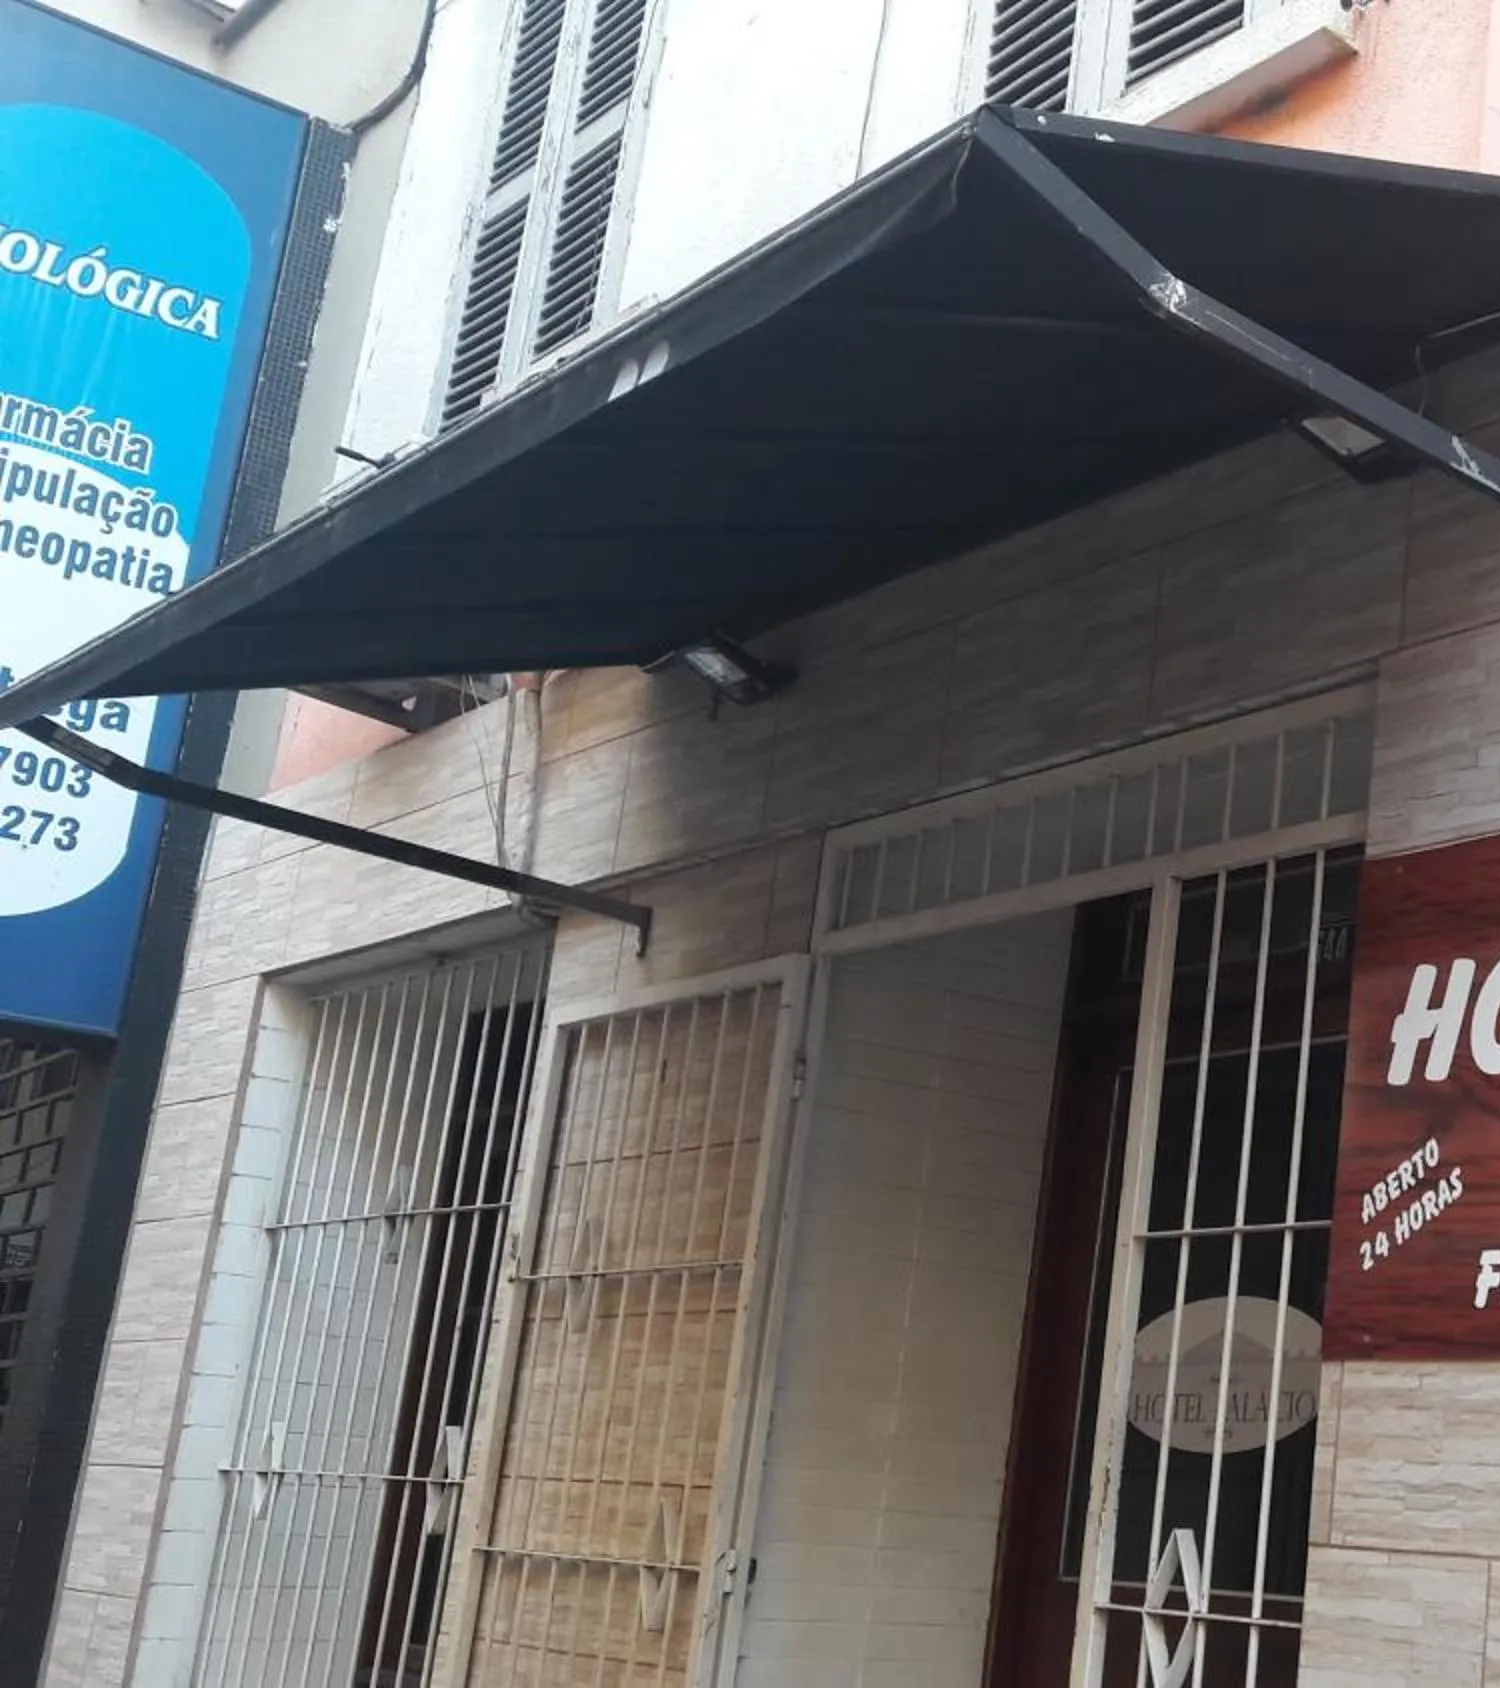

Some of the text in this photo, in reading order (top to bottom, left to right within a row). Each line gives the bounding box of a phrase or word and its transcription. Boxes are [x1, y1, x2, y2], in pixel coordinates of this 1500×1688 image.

[0, 225, 221, 338] OLÓGICA
[0, 394, 151, 471] rmácia
[1360, 1166, 1464, 1271] 24 HORAS
[1361, 1136, 1440, 1224] ABERTO
